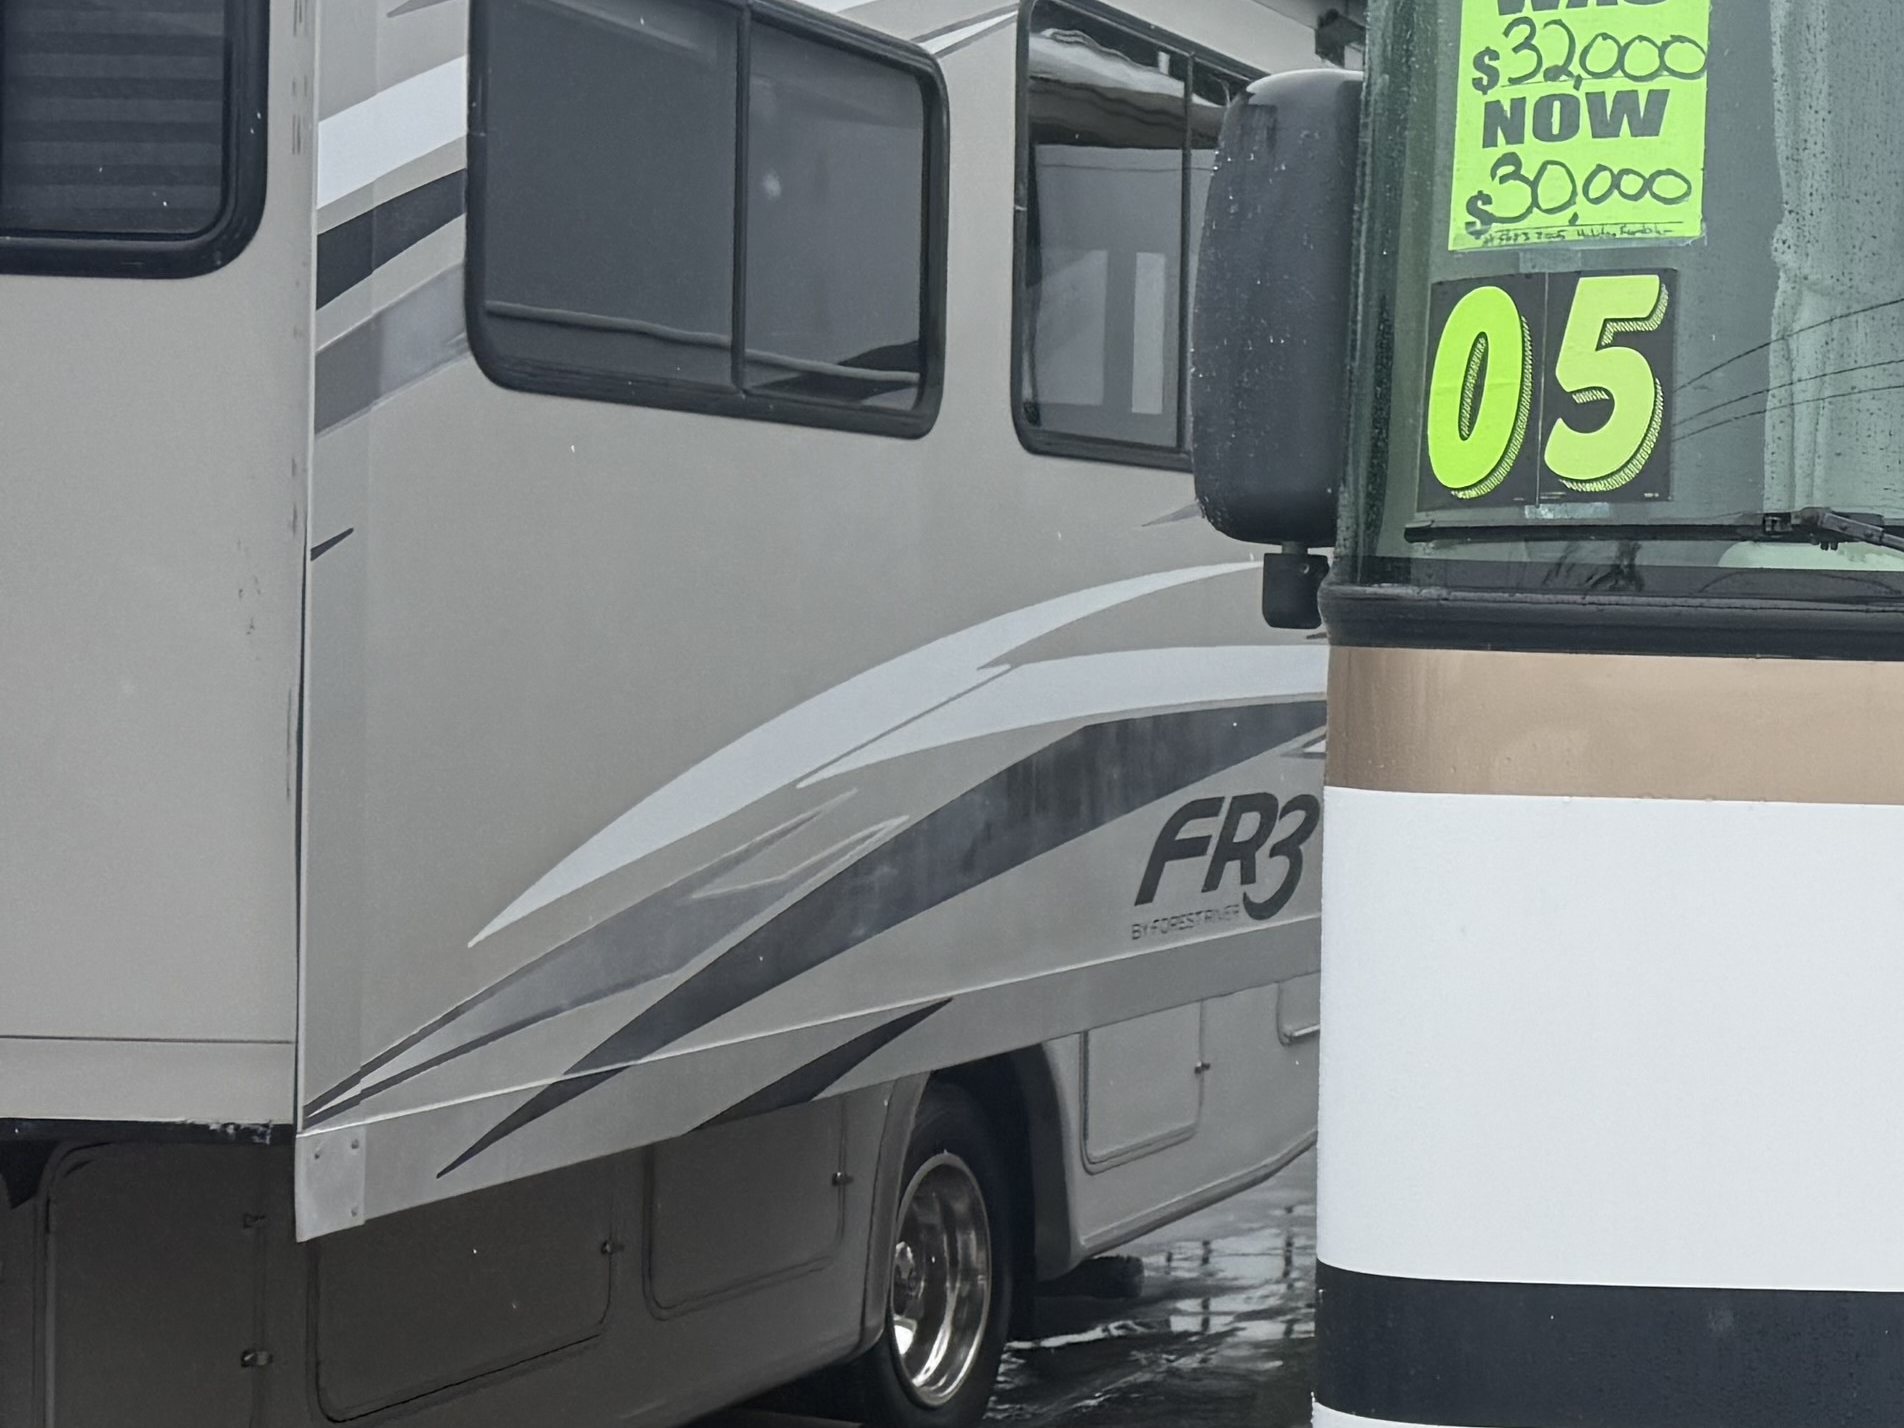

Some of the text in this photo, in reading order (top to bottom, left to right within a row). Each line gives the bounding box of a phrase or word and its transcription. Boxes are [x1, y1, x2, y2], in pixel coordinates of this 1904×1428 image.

[1471, 16, 1708, 96] $32,000
[1482, 88, 1671, 149] NOW
[1464, 151, 1693, 239] $30,000
[1428, 274, 1669, 499] 05
[1134, 792, 1320, 921] FR3
